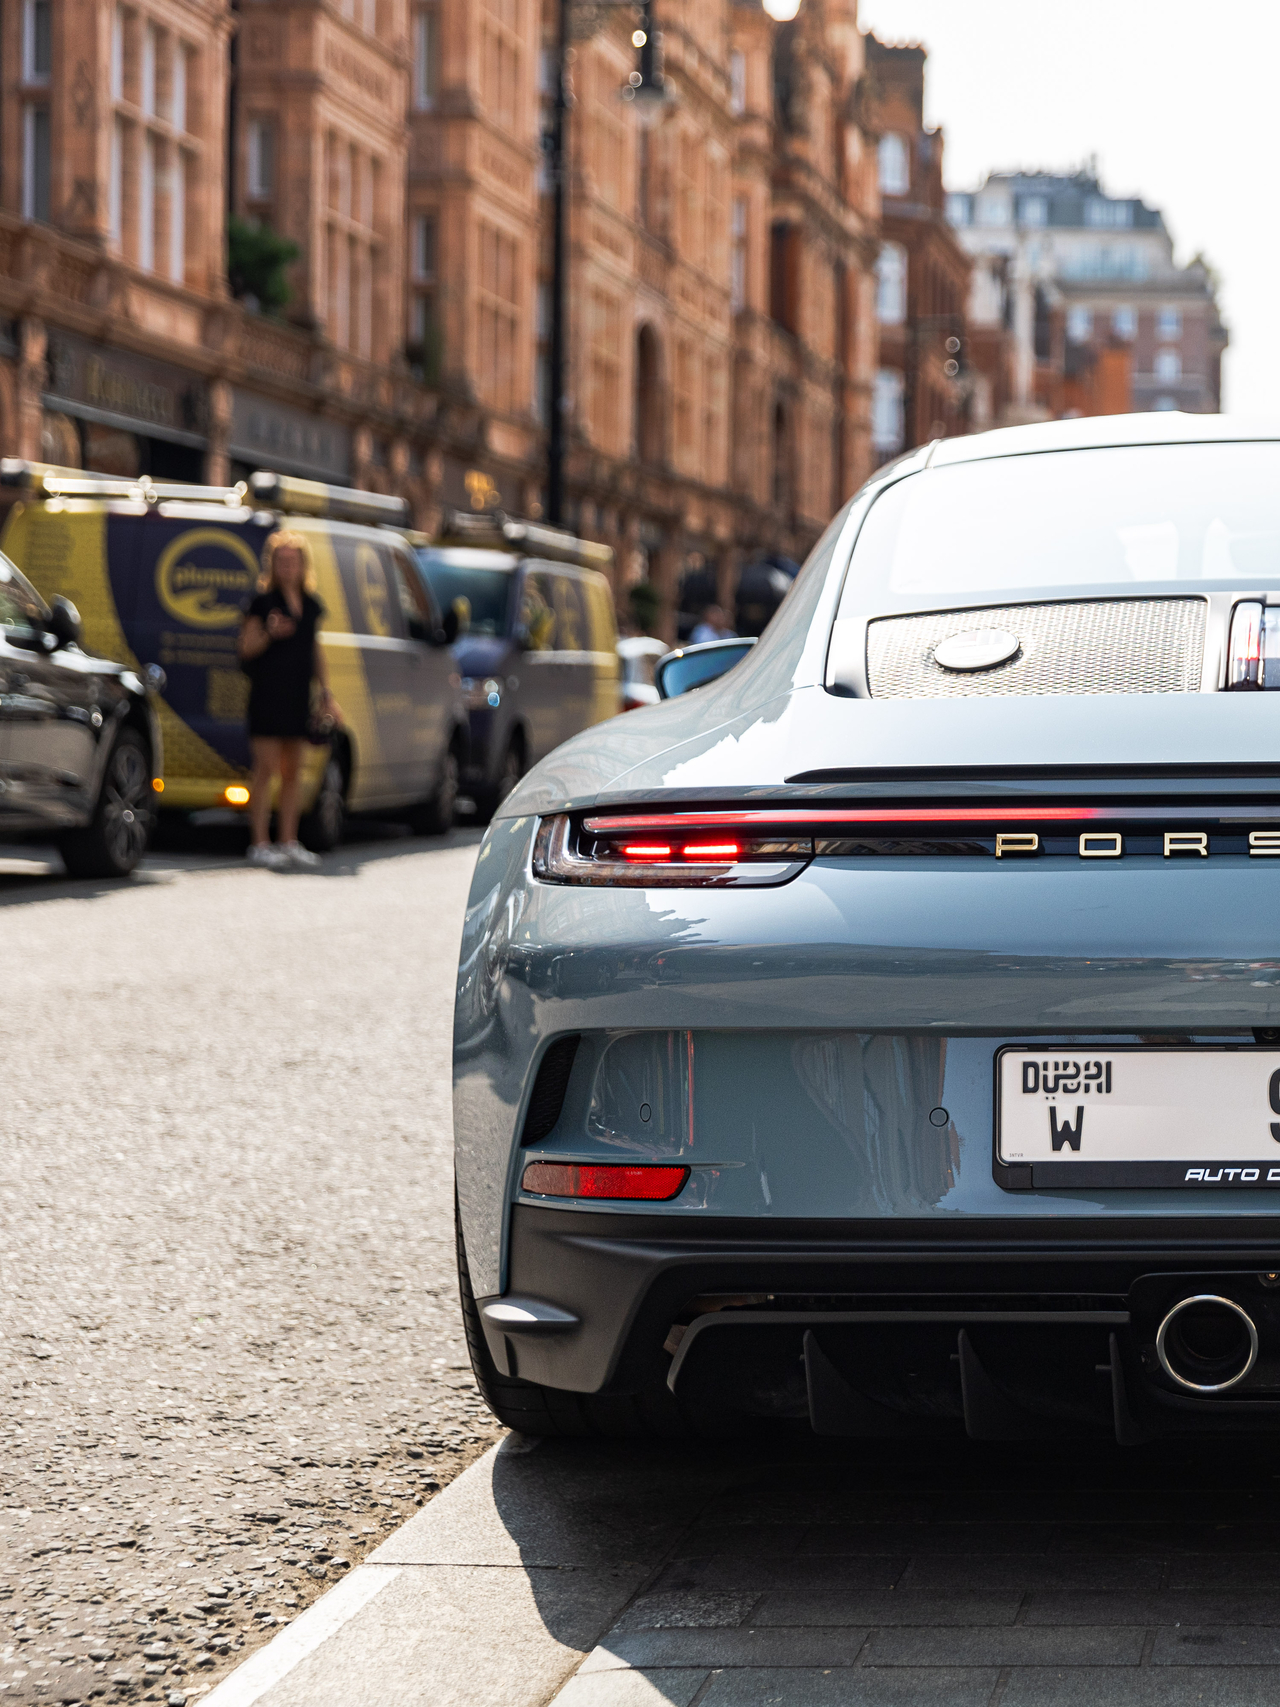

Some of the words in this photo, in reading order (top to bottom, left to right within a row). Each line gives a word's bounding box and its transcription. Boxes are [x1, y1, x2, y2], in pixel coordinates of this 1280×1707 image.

[1022, 1060, 1112, 1094] DUBAI
[1049, 1105, 1085, 1152] W
[1184, 1168, 1261, 1182] AUTO
